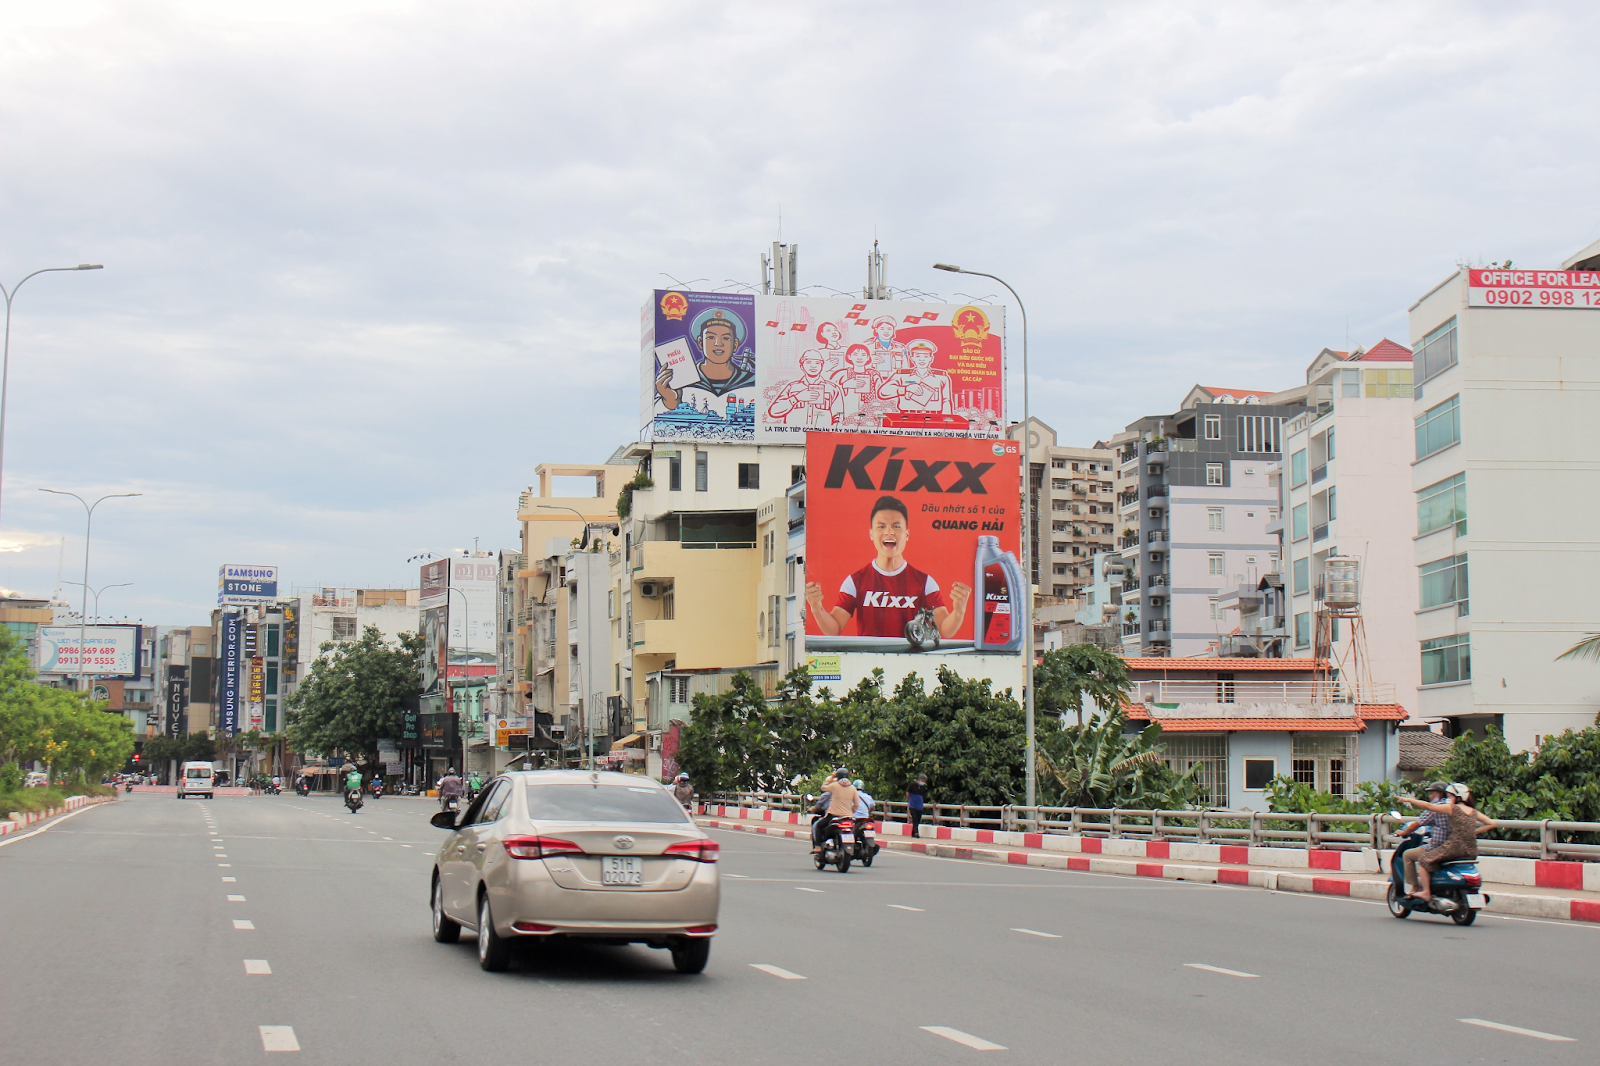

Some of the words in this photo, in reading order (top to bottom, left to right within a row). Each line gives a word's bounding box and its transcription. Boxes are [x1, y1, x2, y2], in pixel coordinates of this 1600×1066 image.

[1481, 271, 1534, 286] OFFICE
[1537, 272, 1569, 286] FOR
[1571, 273, 1600, 287] LEA
[1485, 289, 1533, 305] 0902
[1539, 290, 1575, 306] 998
[1005, 445, 1017, 454] GS
[921, 503, 940, 513] Dầu
[942, 504, 966, 514] nhớt
[967, 504, 979, 514] số
[980, 506, 986, 514] 1
[988, 506, 1005, 515] của
[931, 519, 979, 531] QUANG
[981, 517, 1004, 531] HẢI
[227, 568, 274, 578] SAMSUNG
[227, 583, 262, 592] STONE
[58, 646, 80, 655] 0986
[99, 647, 116, 656] 689
[226, 618, 236, 688] INTERIOR.COM
[58, 657, 79, 665] 0913
[94, 657, 115, 665] 5555
[225, 690, 234, 739] SAMSUNG
[404, 714, 417, 722] Golf
[403, 731, 418, 740] Shop
[612, 857, 634, 871] 51H
[603, 871, 642, 884] 02073
